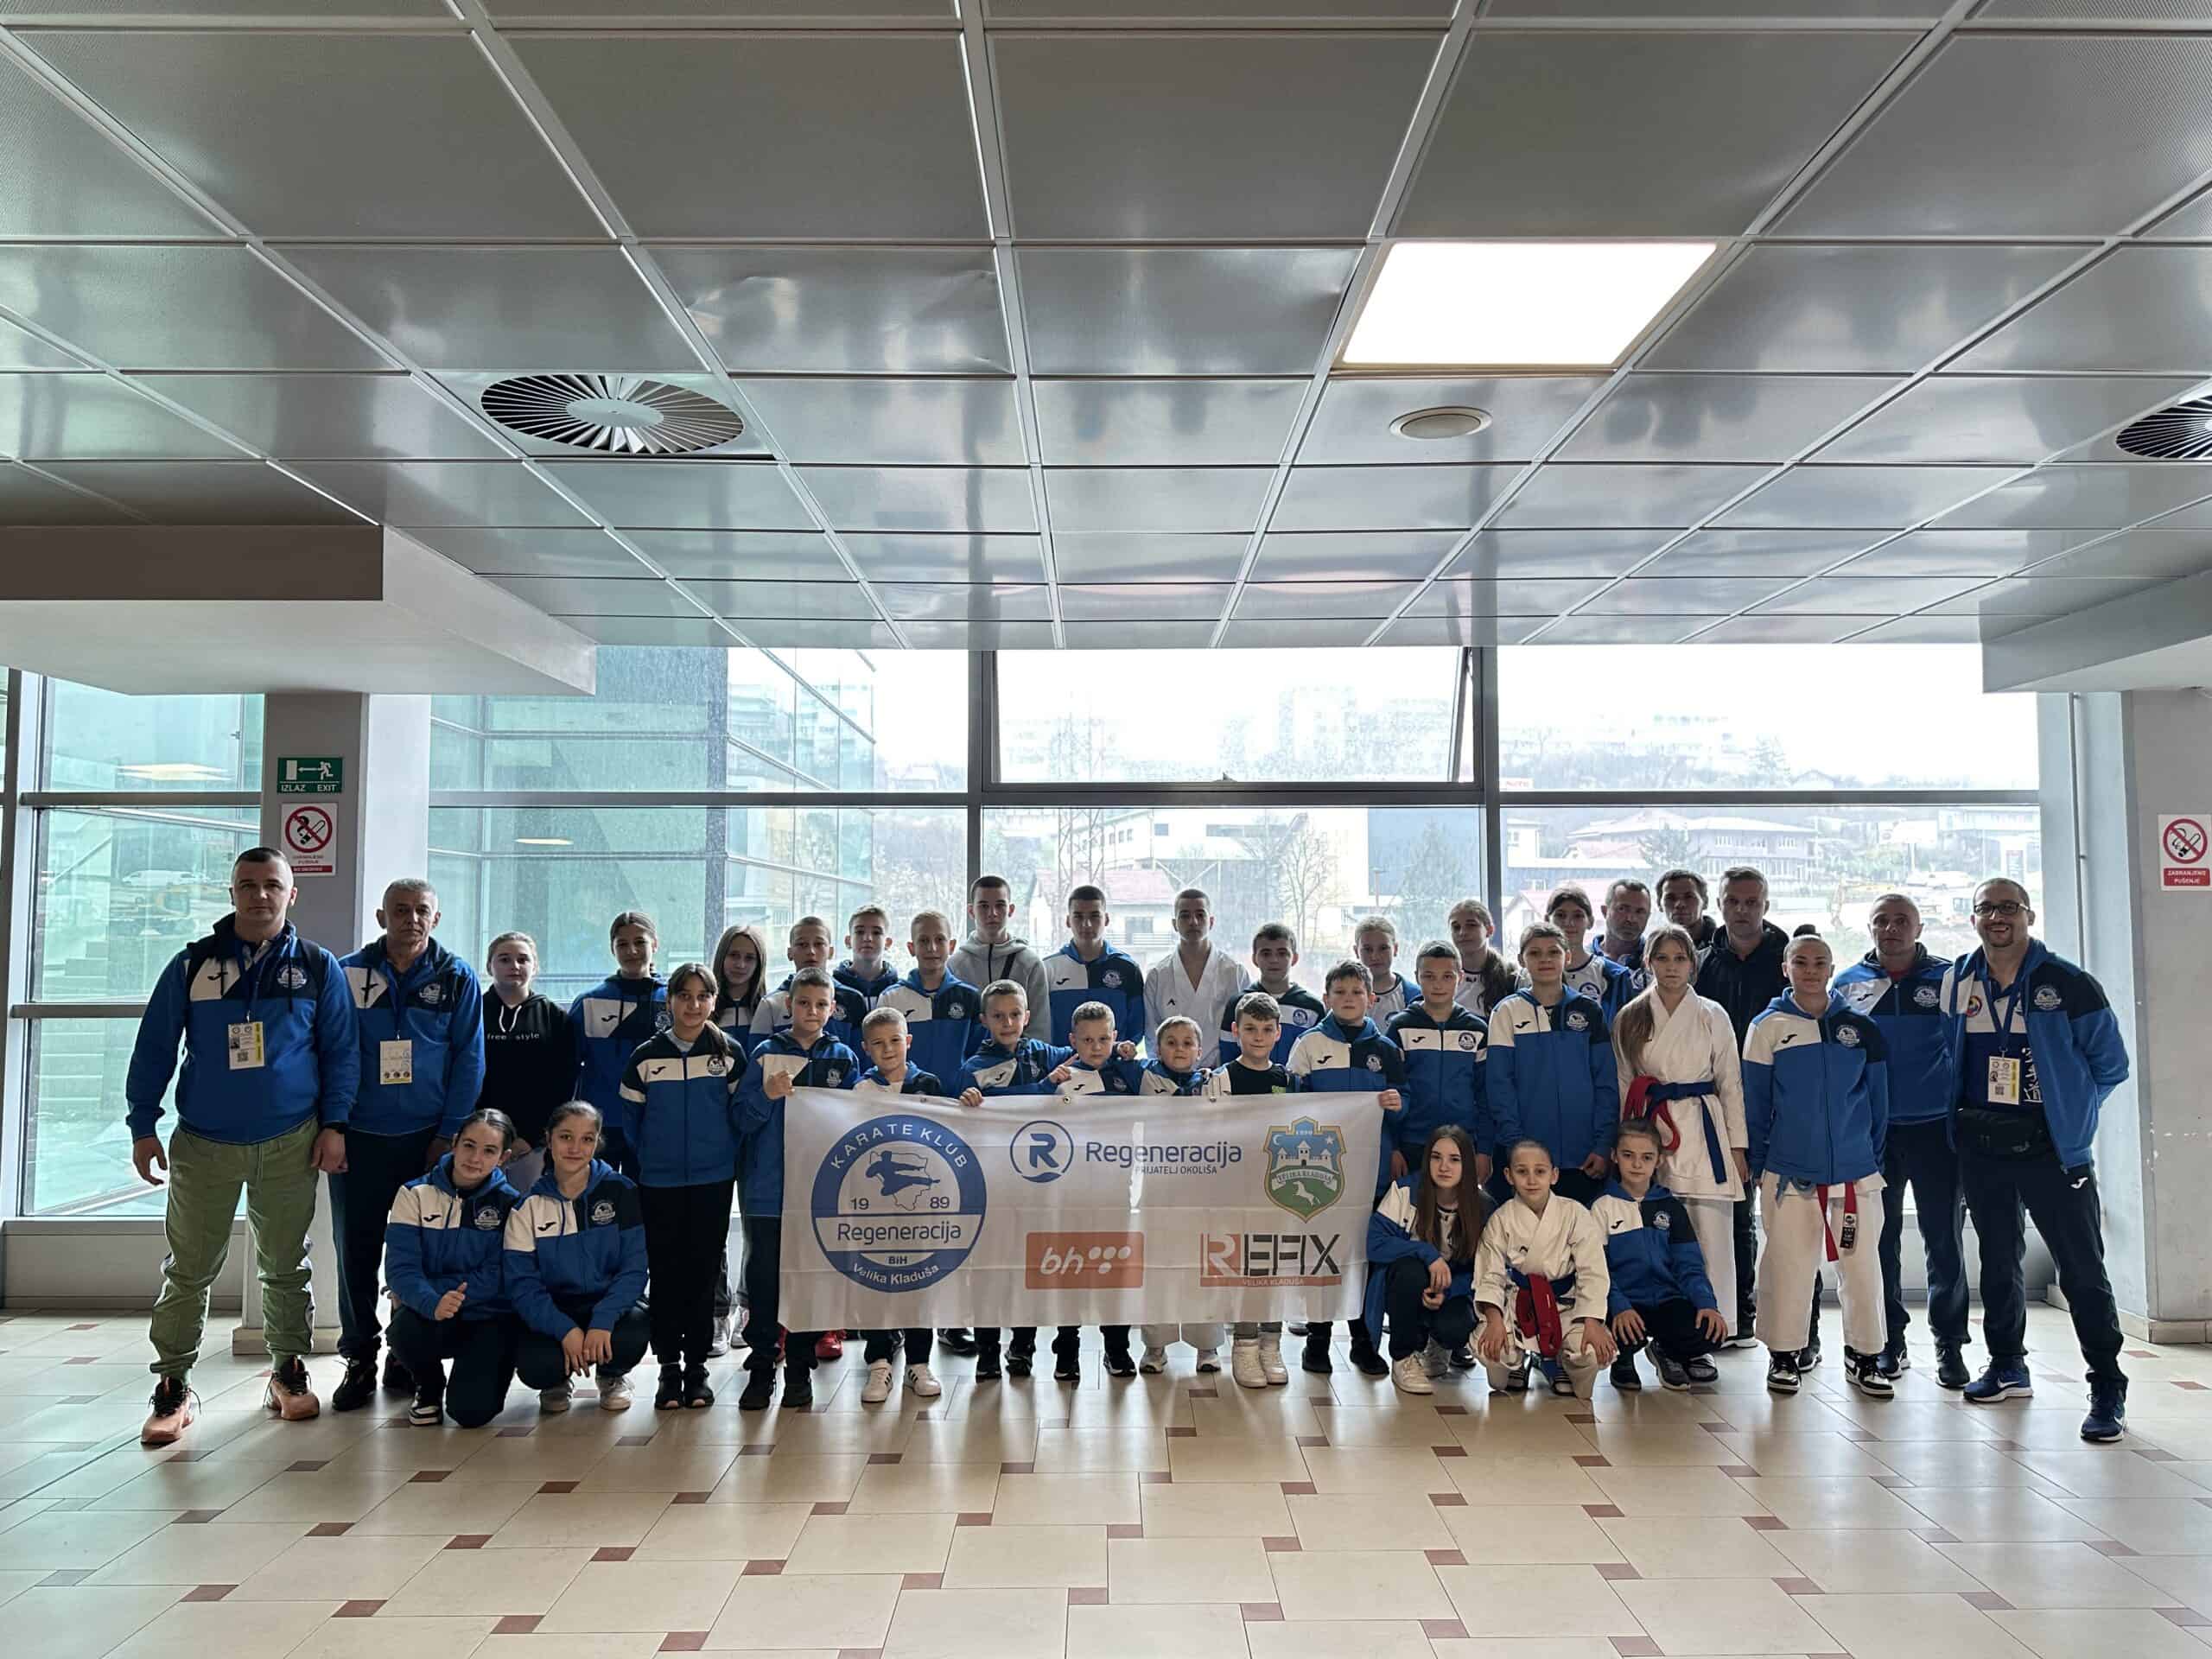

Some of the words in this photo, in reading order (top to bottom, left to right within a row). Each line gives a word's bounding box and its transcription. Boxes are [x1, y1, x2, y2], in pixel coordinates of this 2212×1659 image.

[281, 784, 306, 792] IZLAZ
[317, 784, 337, 792] EXIT
[830, 1123, 913, 1169] KARATE
[919, 1128, 968, 1168] KLUB
[1085, 1141, 1243, 1168] Regeneracija
[1180, 1164, 1217, 1175] OKOLIŠA
[850, 1198, 870, 1211] 19
[930, 1196, 950, 1210] 89
[836, 1221, 962, 1245] Regeneracija
[887, 1255, 908, 1265] BiH
[1039, 1246, 1084, 1275] bh
[1202, 1233, 1341, 1276] REFIX
[854, 1262, 887, 1284] Velika
[890, 1264, 939, 1286] Kladuša
